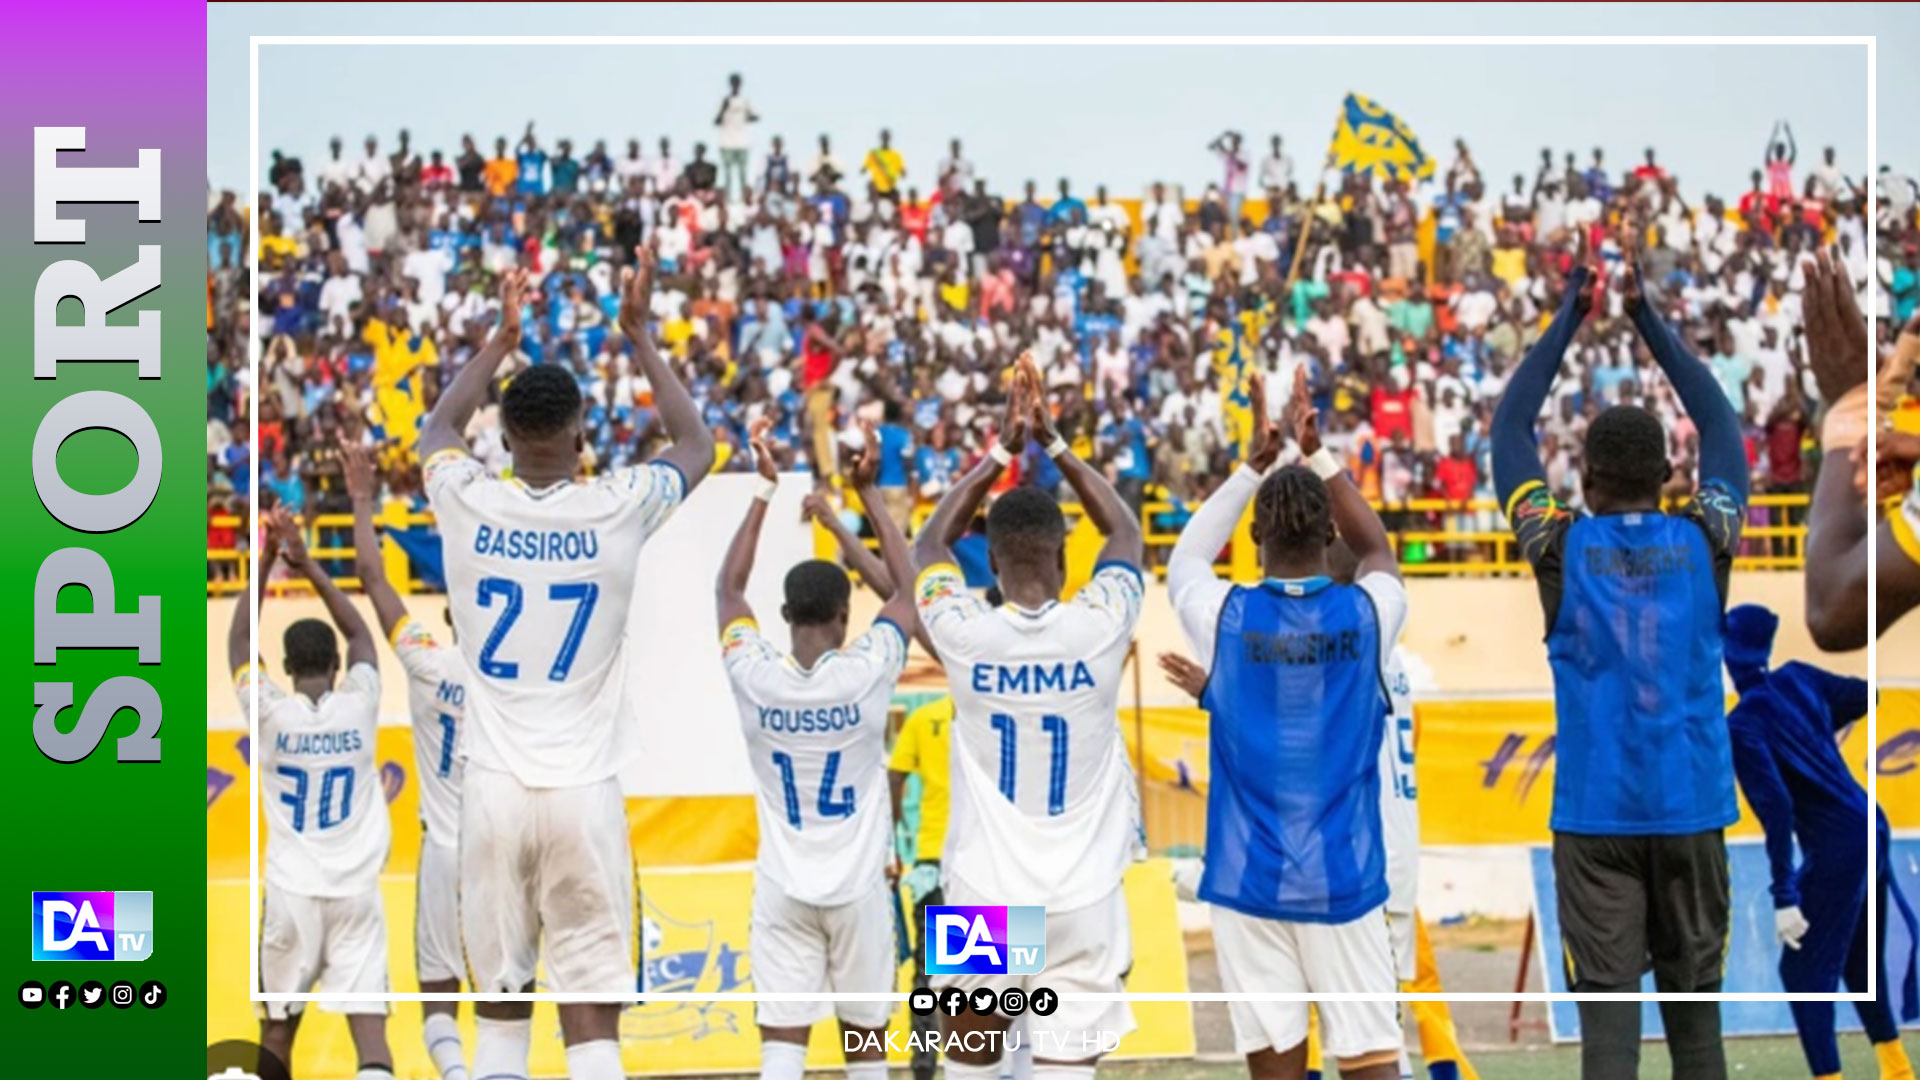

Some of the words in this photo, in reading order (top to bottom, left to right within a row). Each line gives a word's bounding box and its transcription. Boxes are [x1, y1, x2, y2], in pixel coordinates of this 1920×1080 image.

[474, 524, 598, 561] BASSIROU
[476, 576, 599, 682] 27
[972, 660, 1095, 694] EMMA
[275, 729, 362, 755] M.JACQUES
[758, 702, 861, 733] YOUSSOU
[771, 750, 857, 831] 14
[990, 713, 1068, 816] 11
[276, 765, 355, 834] 30
